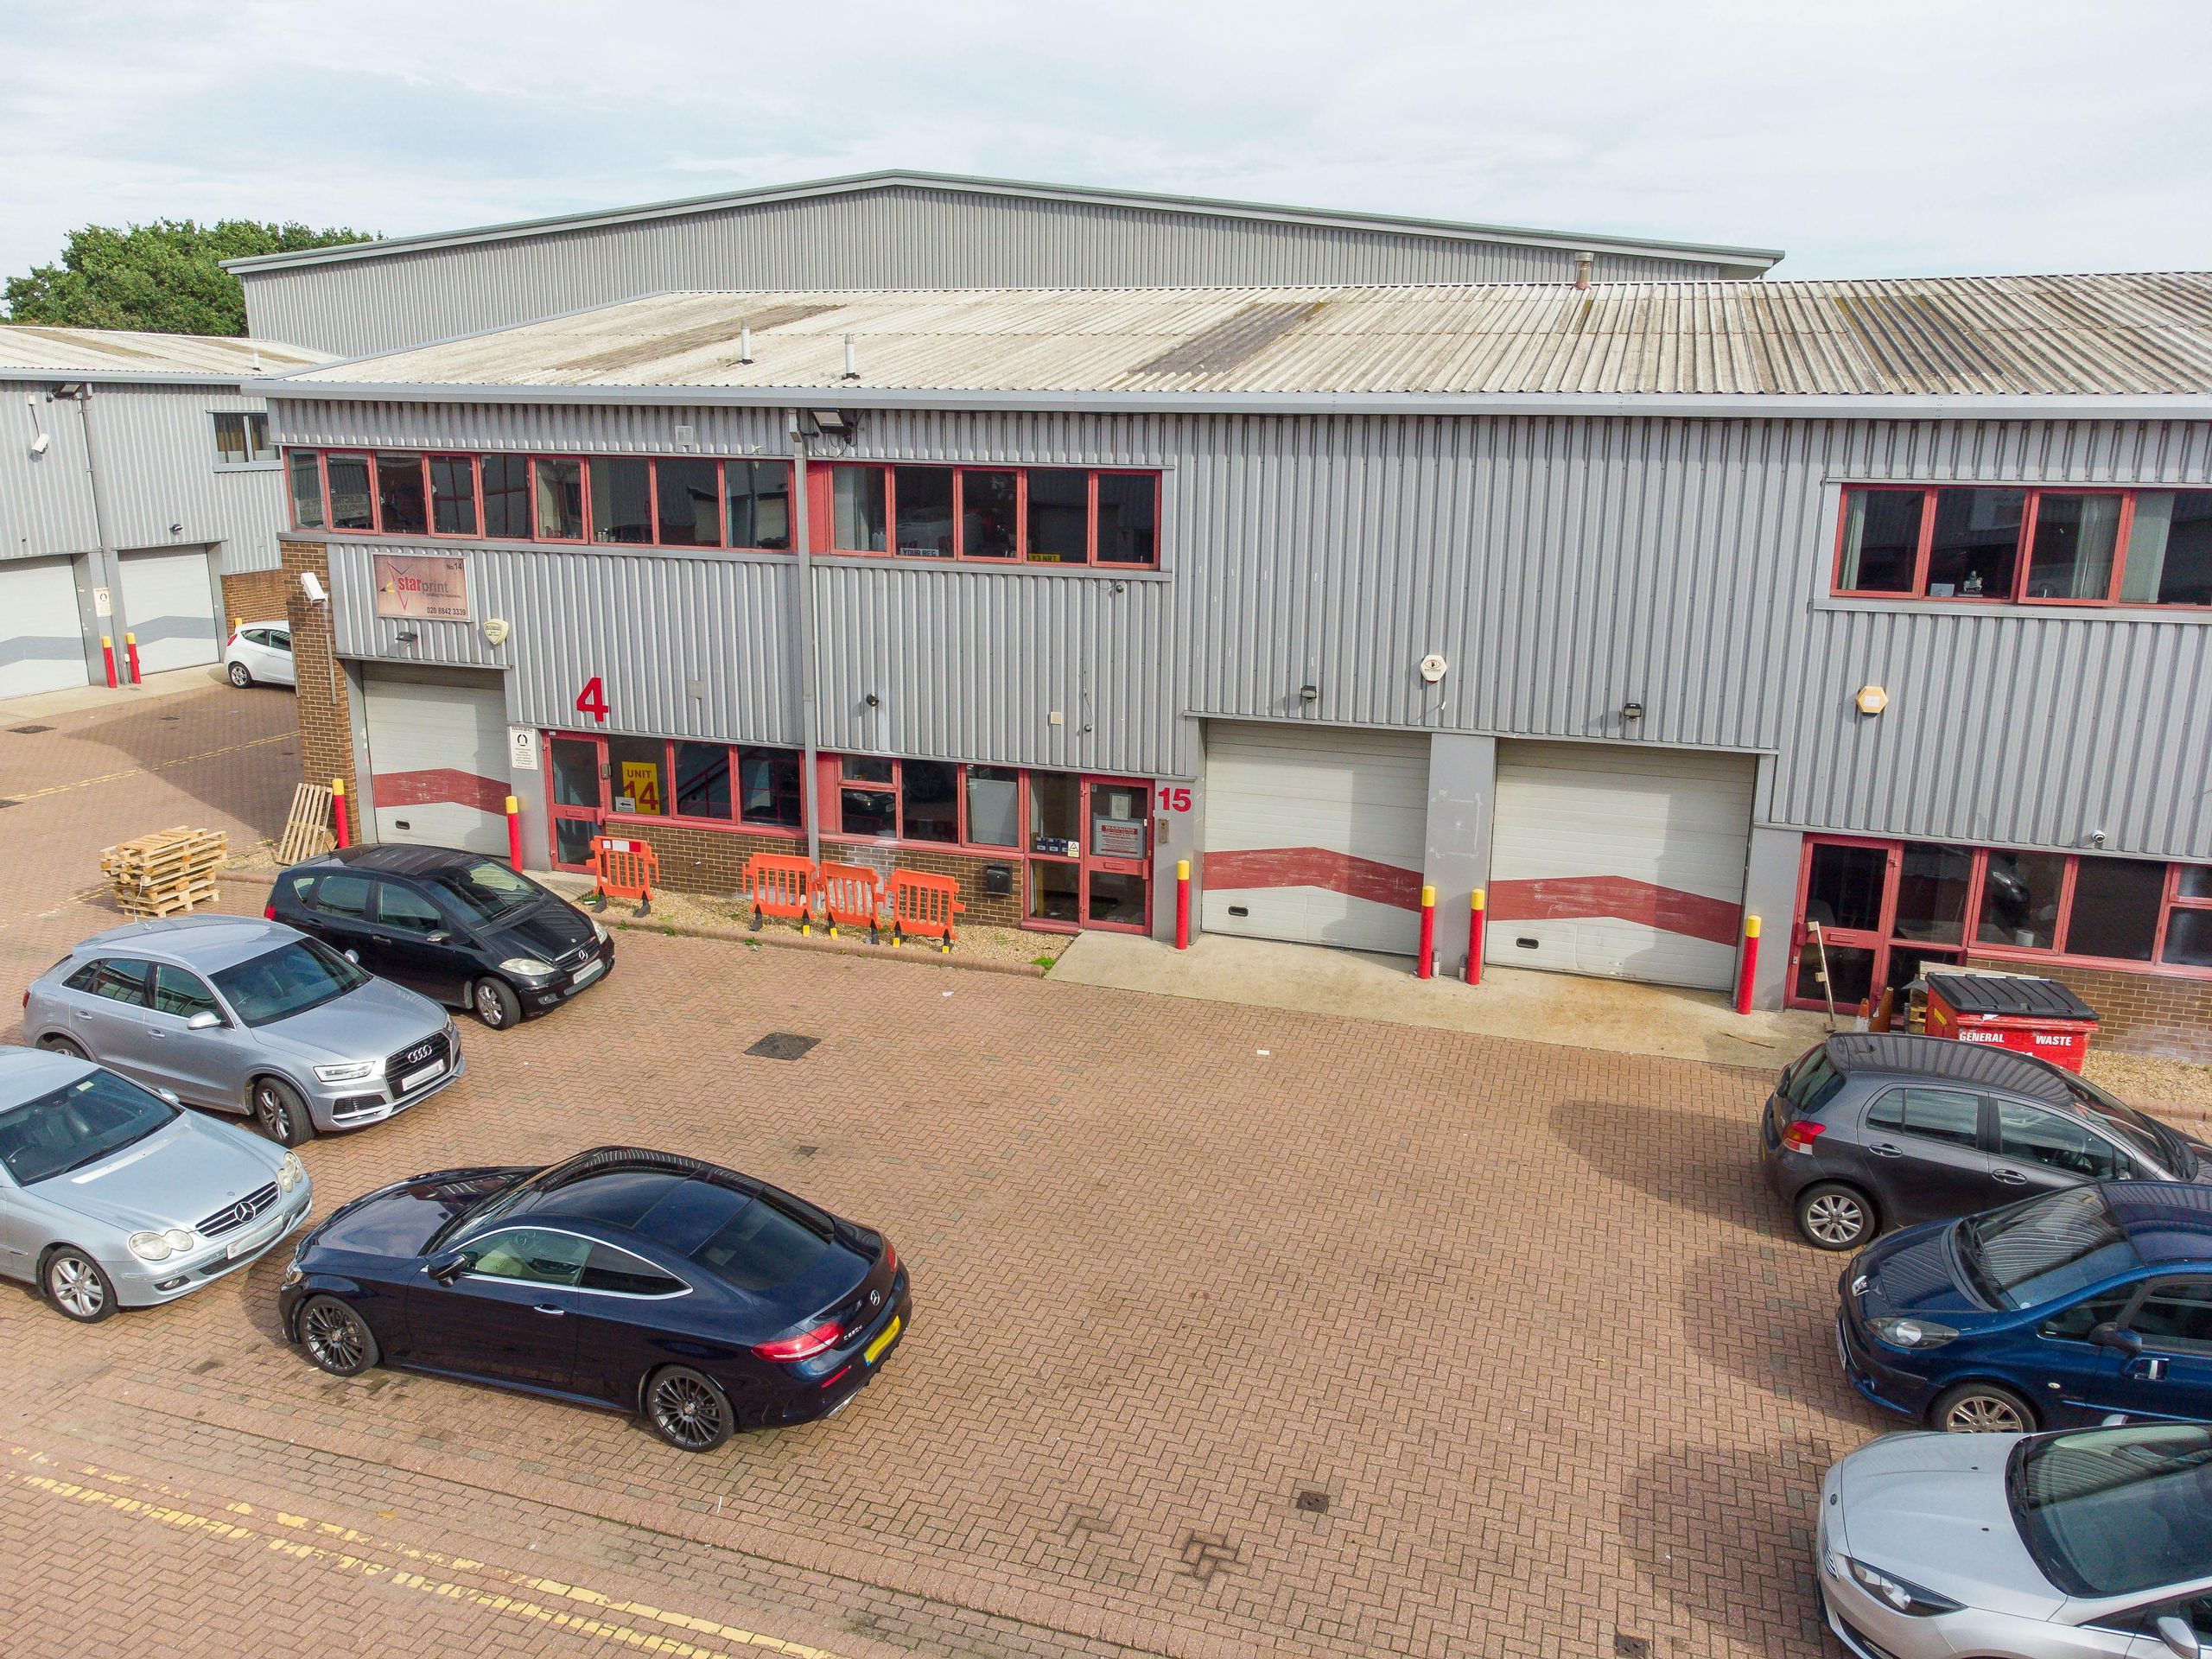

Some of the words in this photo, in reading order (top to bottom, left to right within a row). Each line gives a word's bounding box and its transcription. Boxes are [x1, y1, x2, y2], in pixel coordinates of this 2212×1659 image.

[576, 677, 609, 722] 4
[626, 769, 652, 779] UNIT
[624, 780, 659, 810] 14
[1158, 787, 1192, 812] 15
[1958, 1031, 2005, 1043] GENERAL
[2035, 1035, 2073, 1046] WASTE
